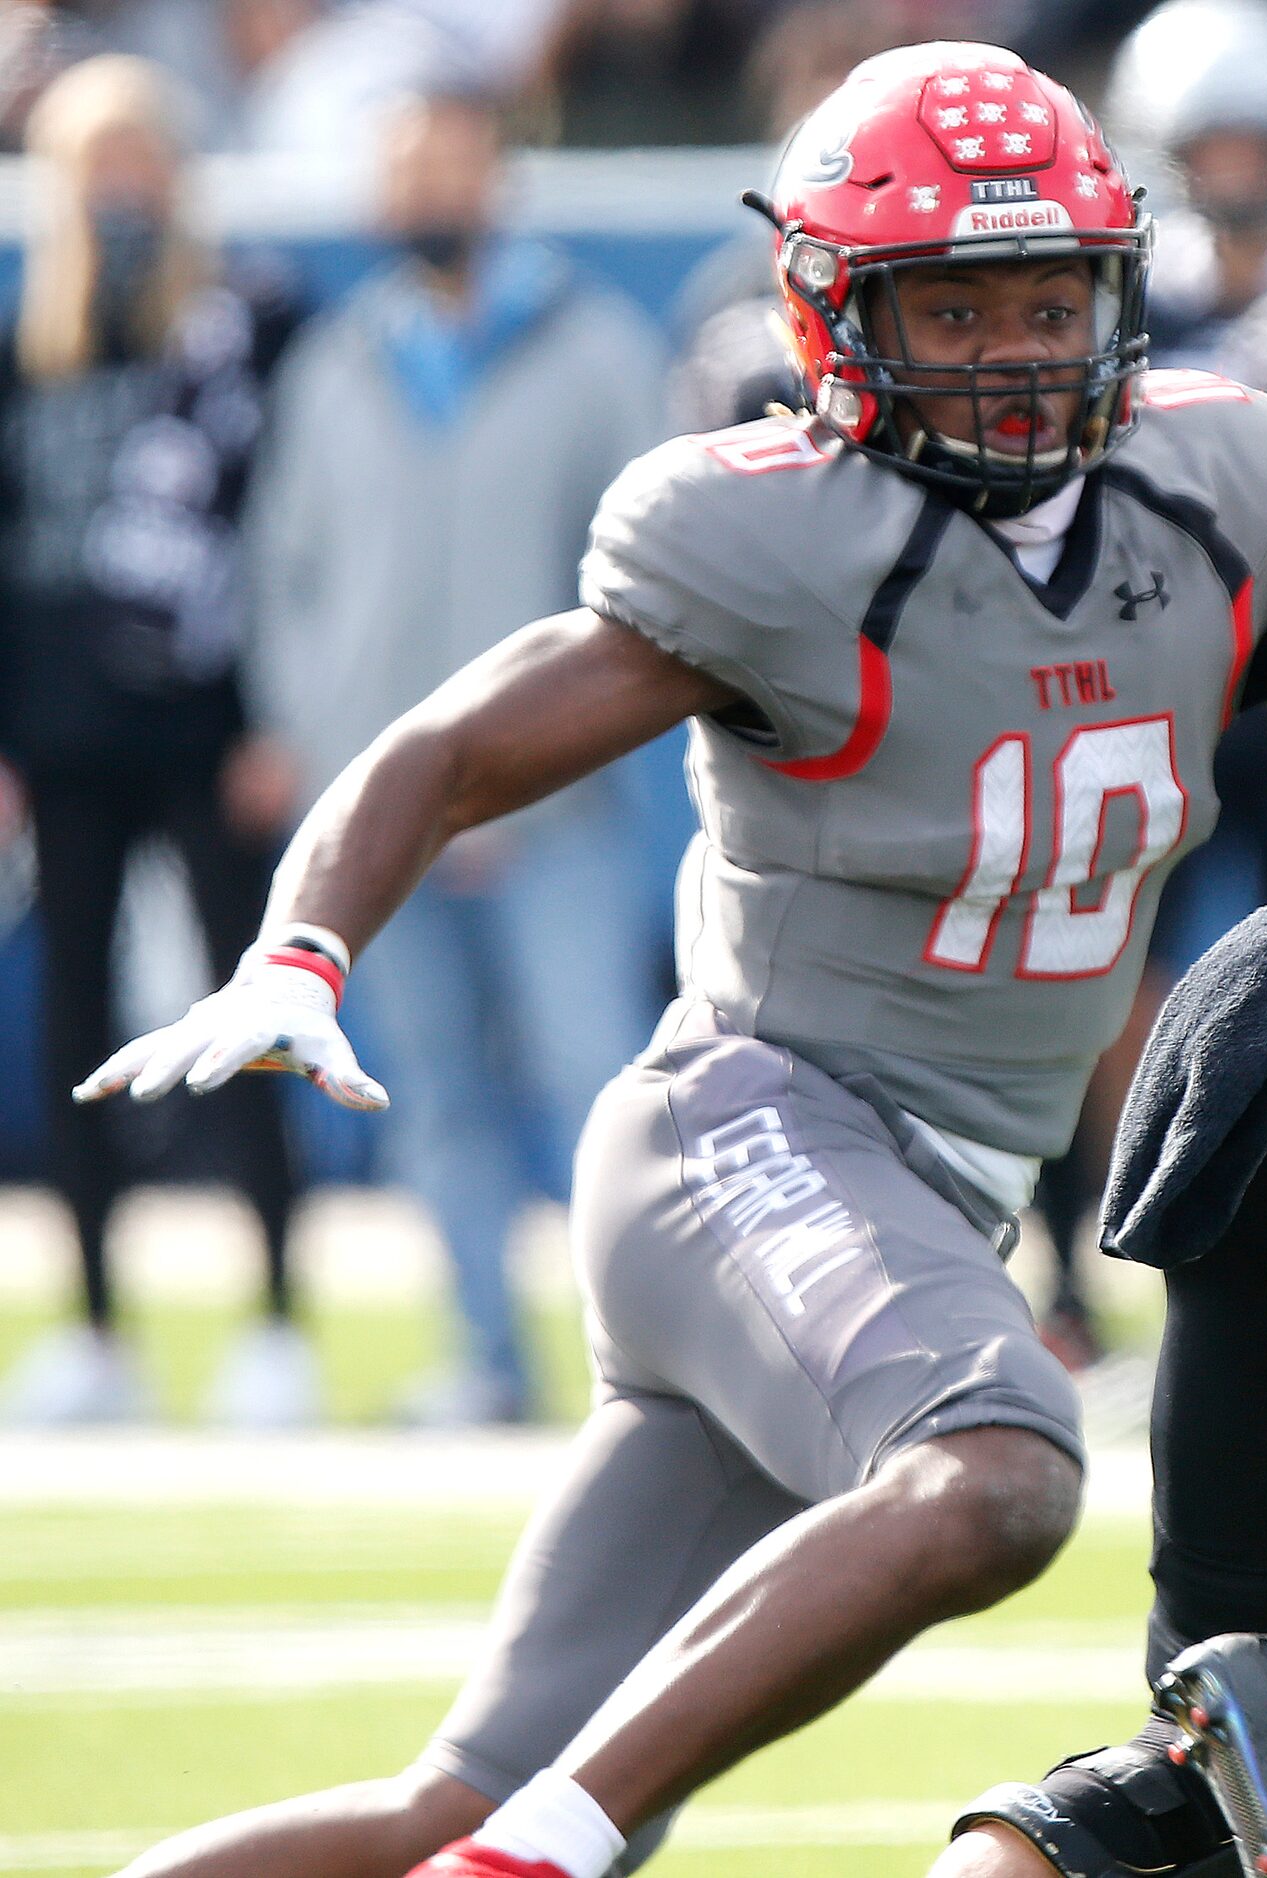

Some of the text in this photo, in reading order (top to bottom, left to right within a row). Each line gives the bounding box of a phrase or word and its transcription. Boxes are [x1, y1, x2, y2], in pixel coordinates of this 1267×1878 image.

[972, 179, 1037, 198] TTHL
[971, 207, 1060, 230] Riddell
[1030, 659, 1117, 711] TTHL
[922, 711, 1189, 981] 10
